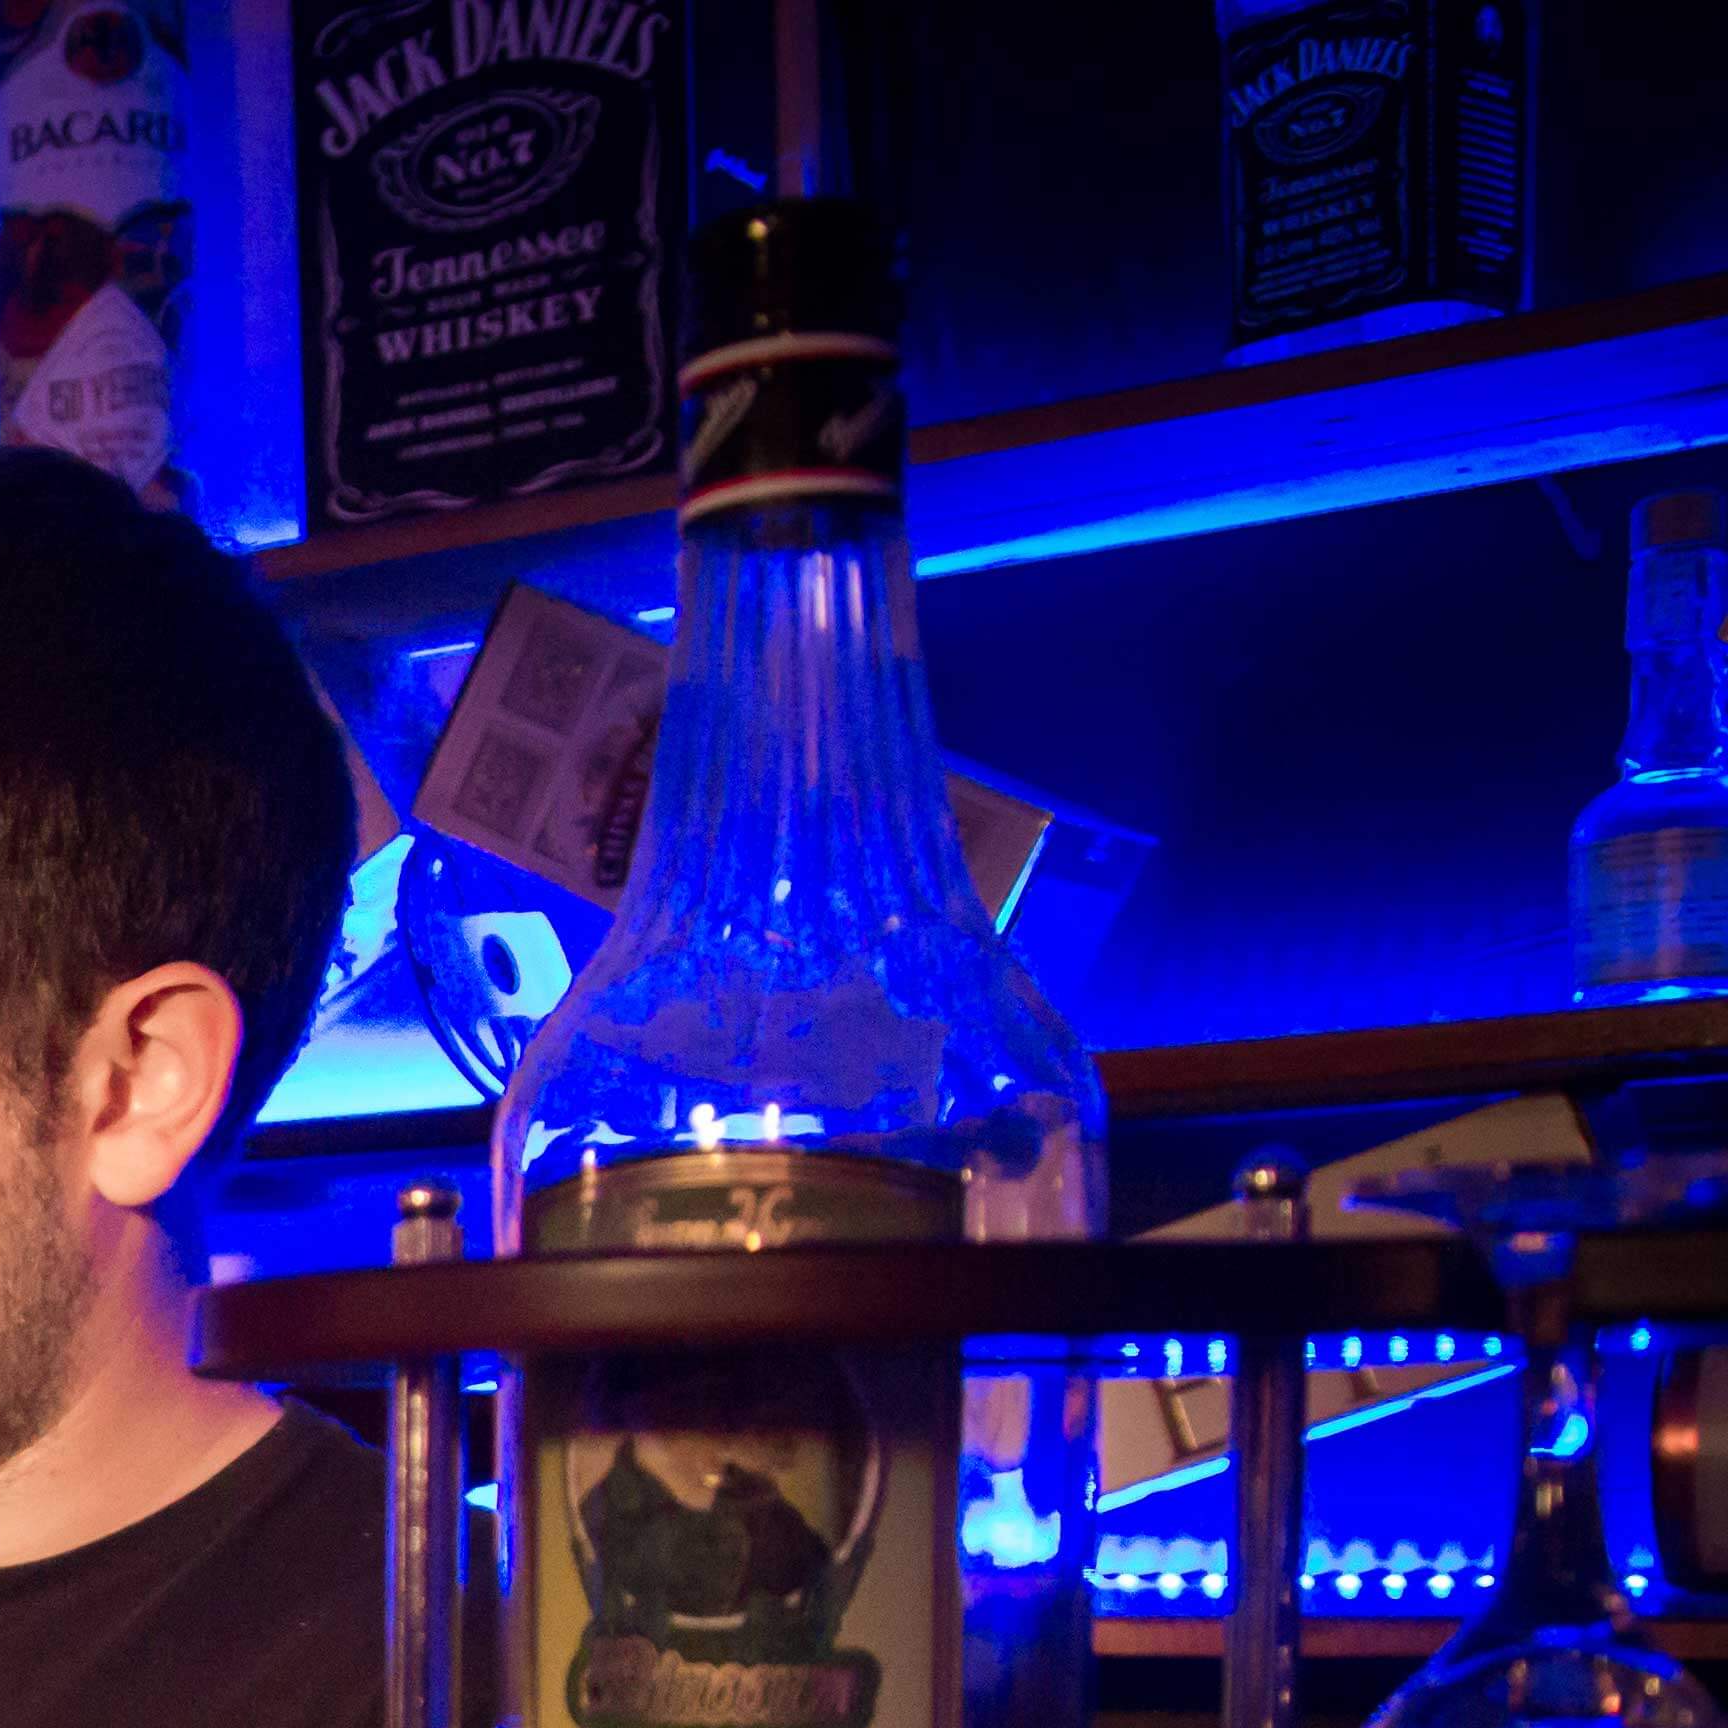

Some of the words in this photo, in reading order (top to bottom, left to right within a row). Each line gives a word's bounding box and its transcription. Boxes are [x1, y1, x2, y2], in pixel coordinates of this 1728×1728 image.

[314, 28, 449, 158] JACK
[1231, 56, 1296, 128] JACK
[370, 219, 606, 298] Tennessee
[375, 285, 604, 364] WHISKEY
